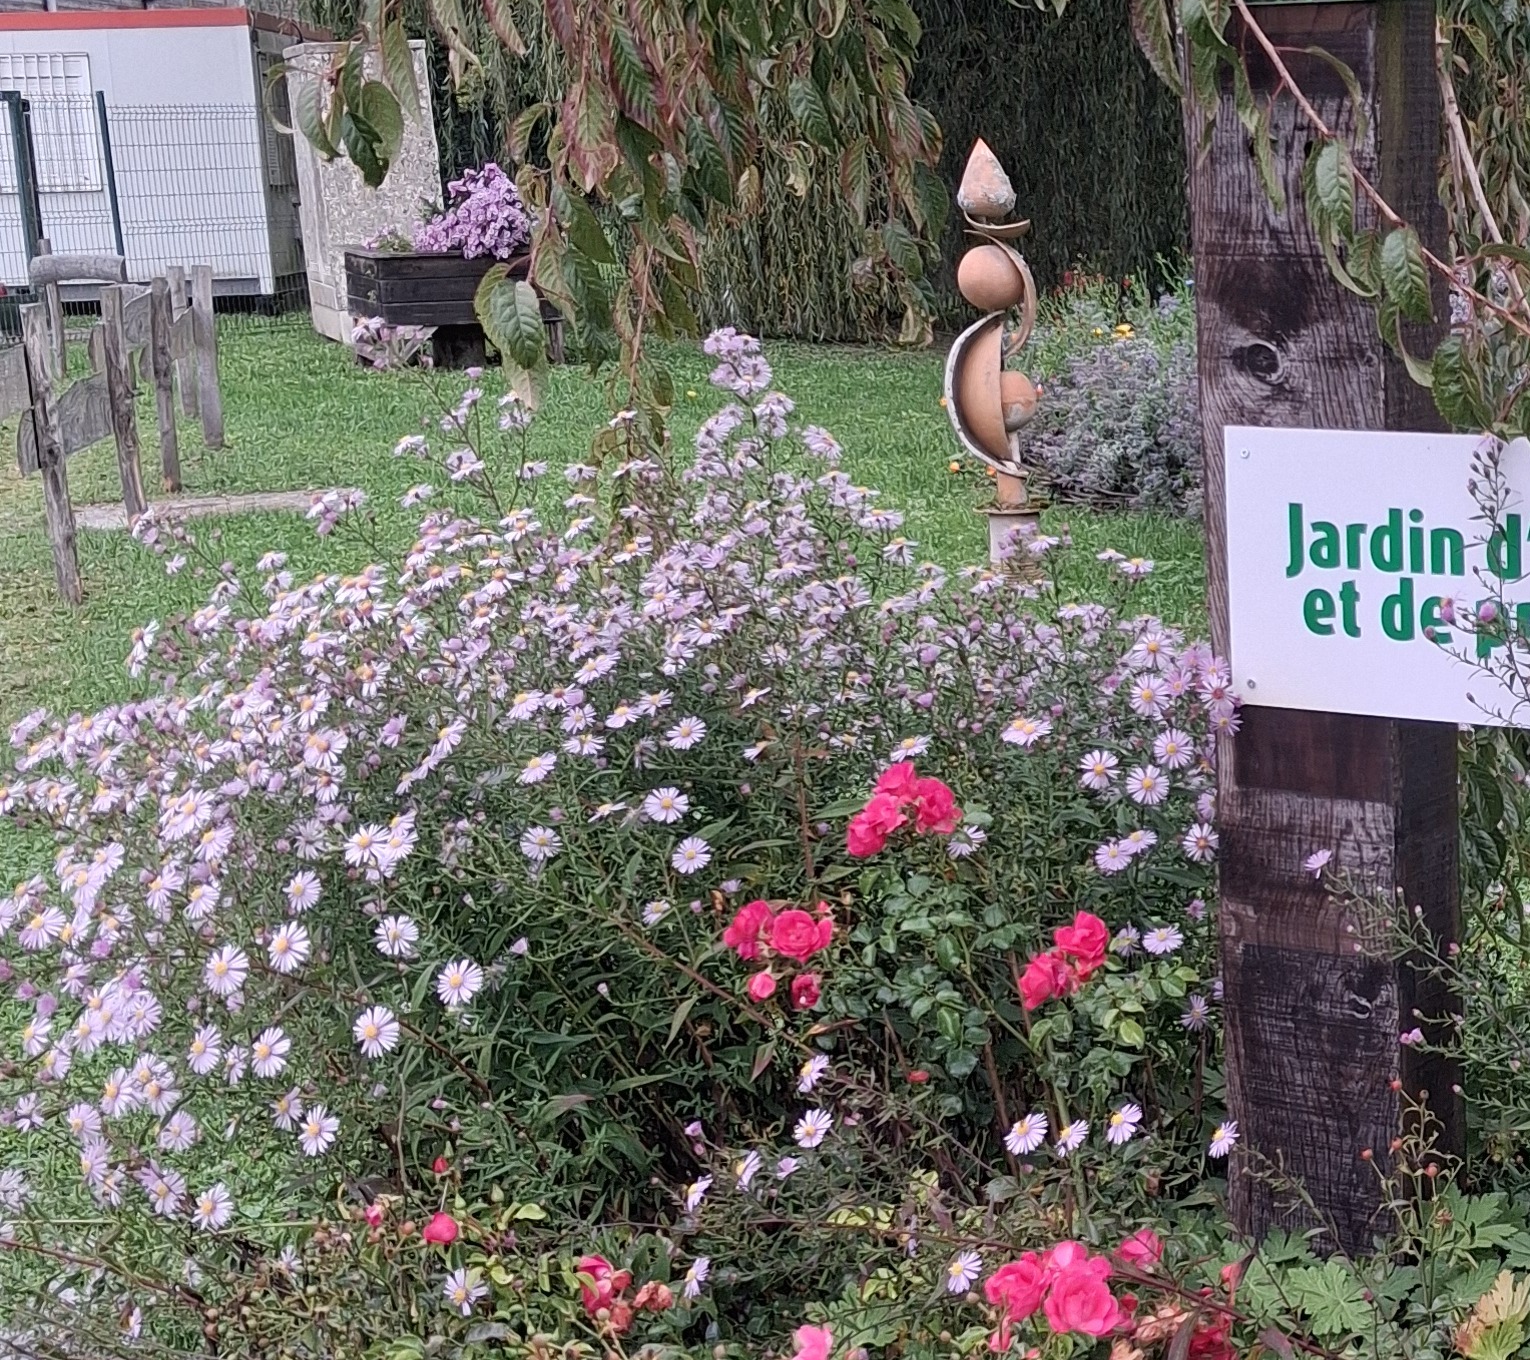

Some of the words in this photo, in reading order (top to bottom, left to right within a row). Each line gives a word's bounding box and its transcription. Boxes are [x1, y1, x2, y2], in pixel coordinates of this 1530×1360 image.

[1286, 502, 1466, 578] Jardin
[1303, 580, 1362, 639] et
[1380, 577, 1454, 644] de
